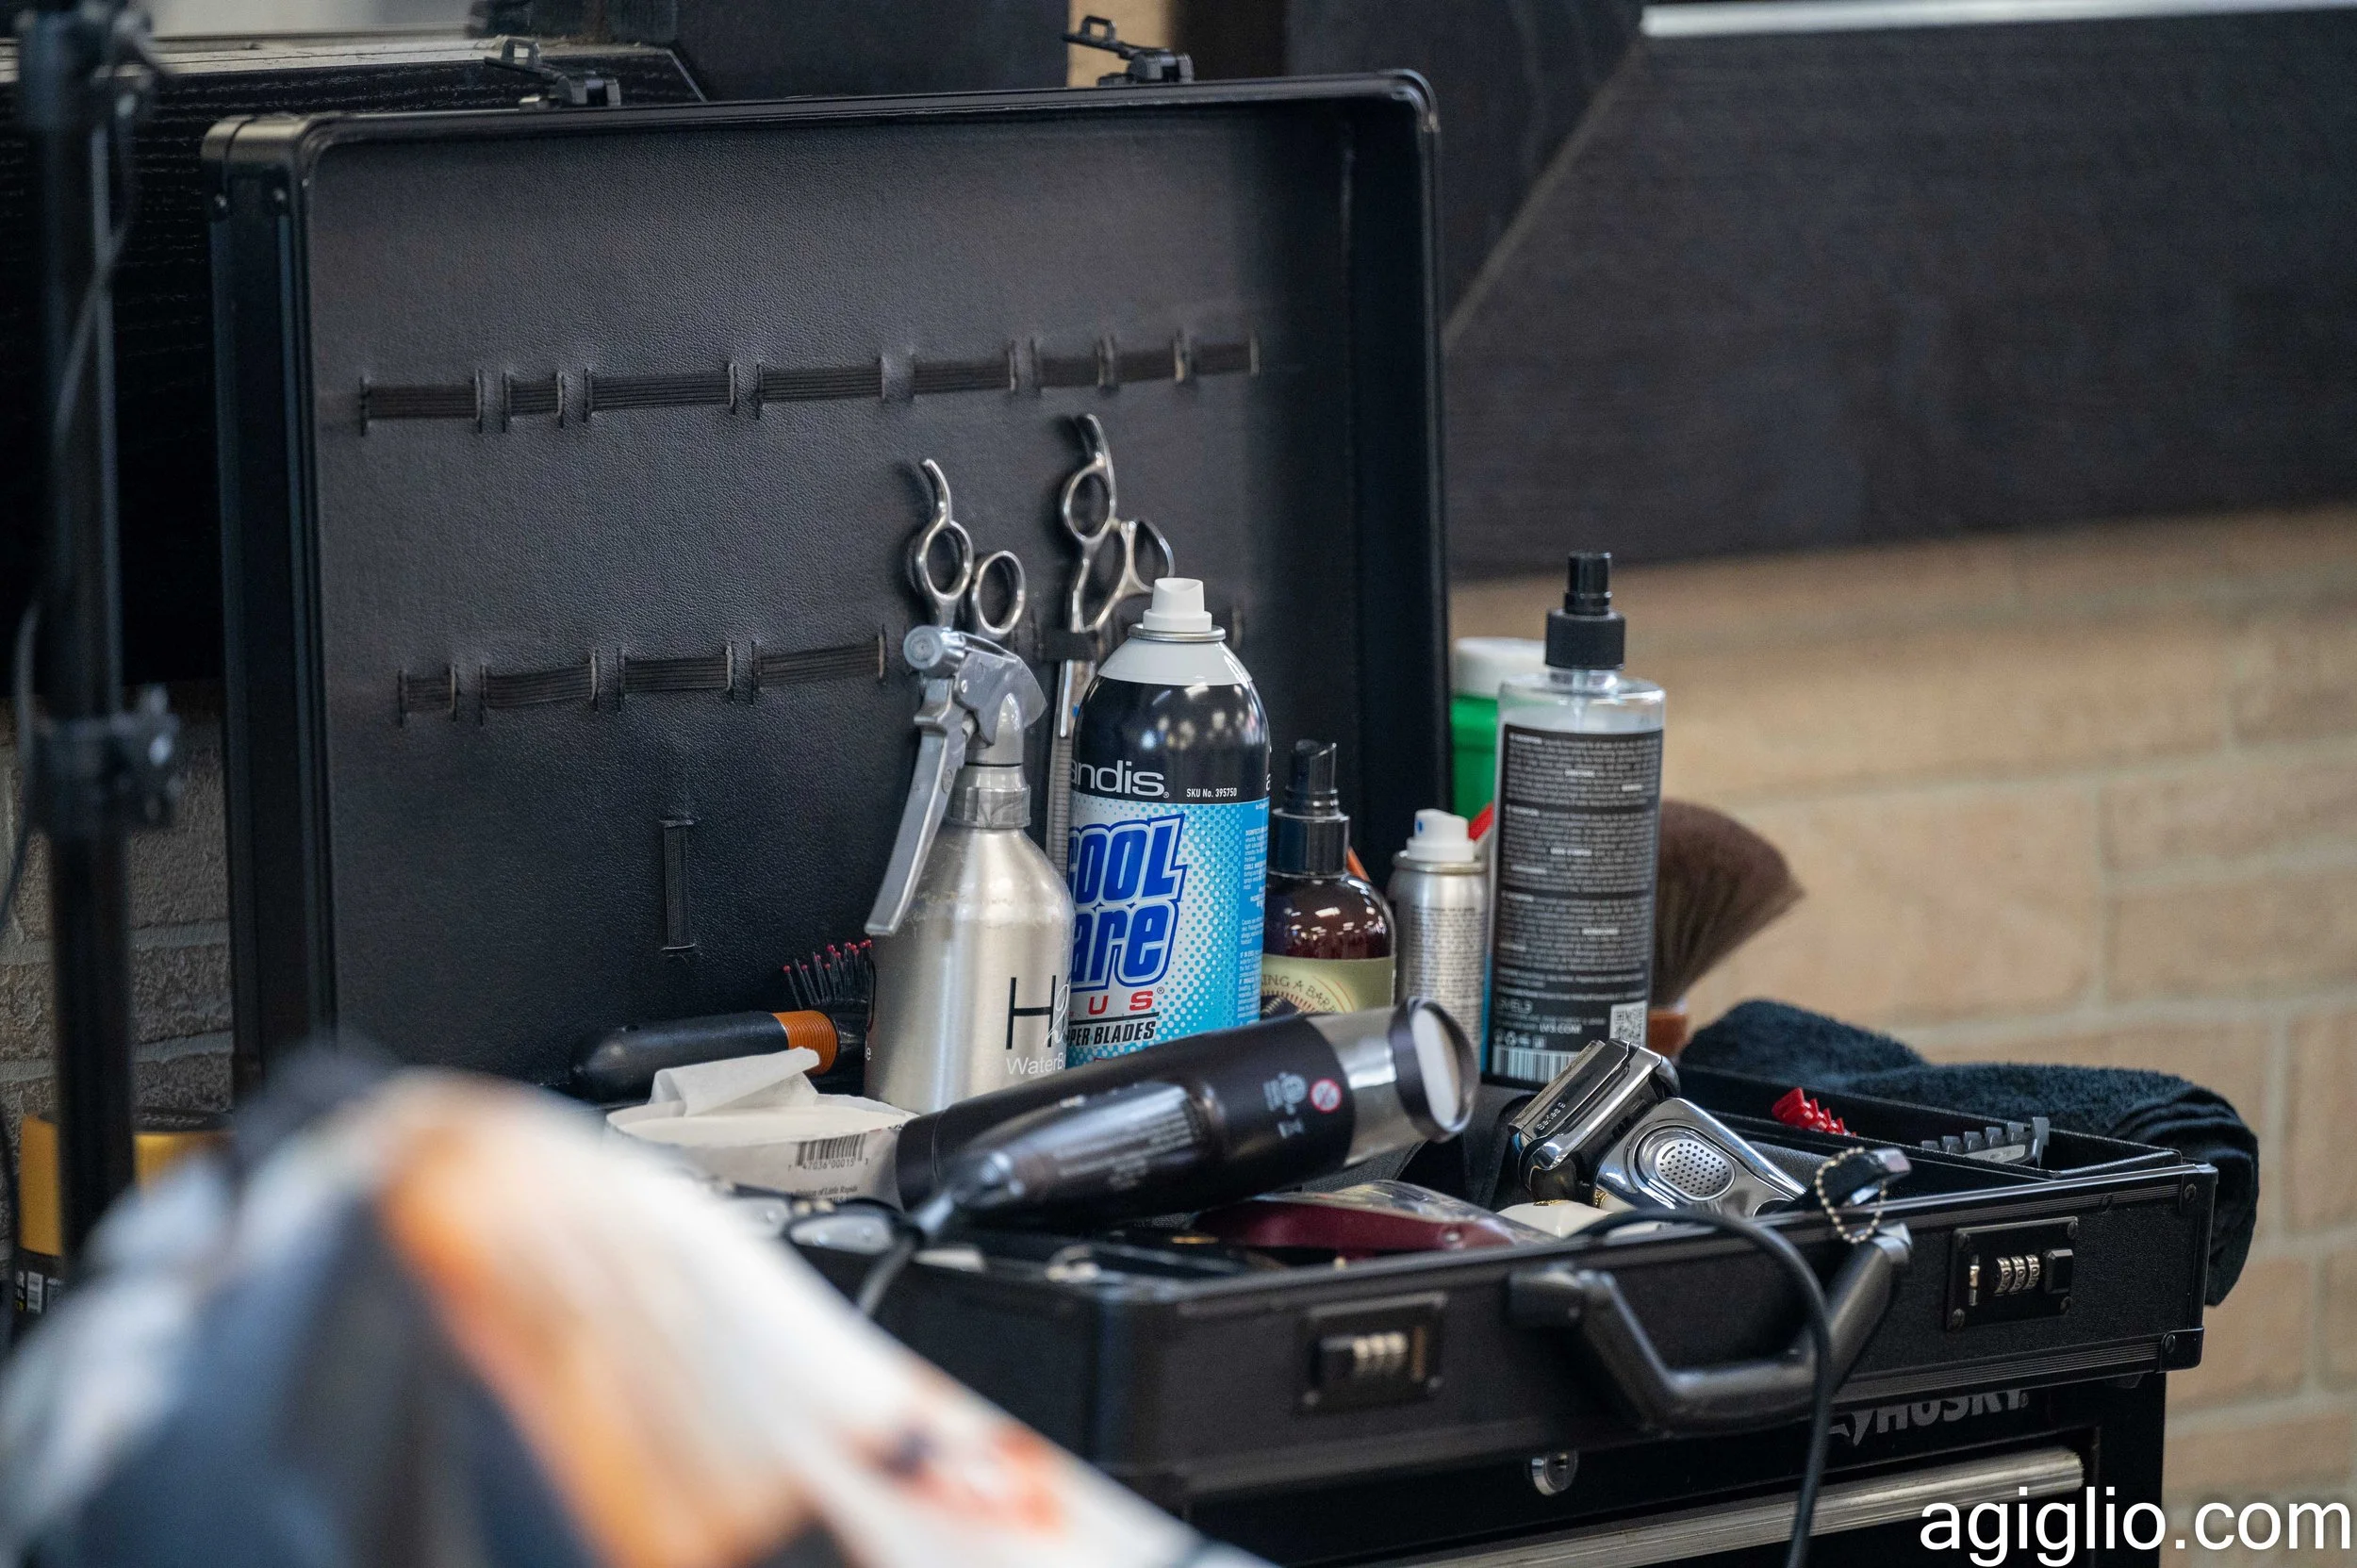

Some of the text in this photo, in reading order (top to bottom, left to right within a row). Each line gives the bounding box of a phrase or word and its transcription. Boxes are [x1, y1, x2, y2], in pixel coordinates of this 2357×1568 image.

[1186, 787, 1238, 798] SKU No. 395750
[1093, 1020, 1157, 1046] BLADES
[1536, 1107, 1562, 1131] Series
